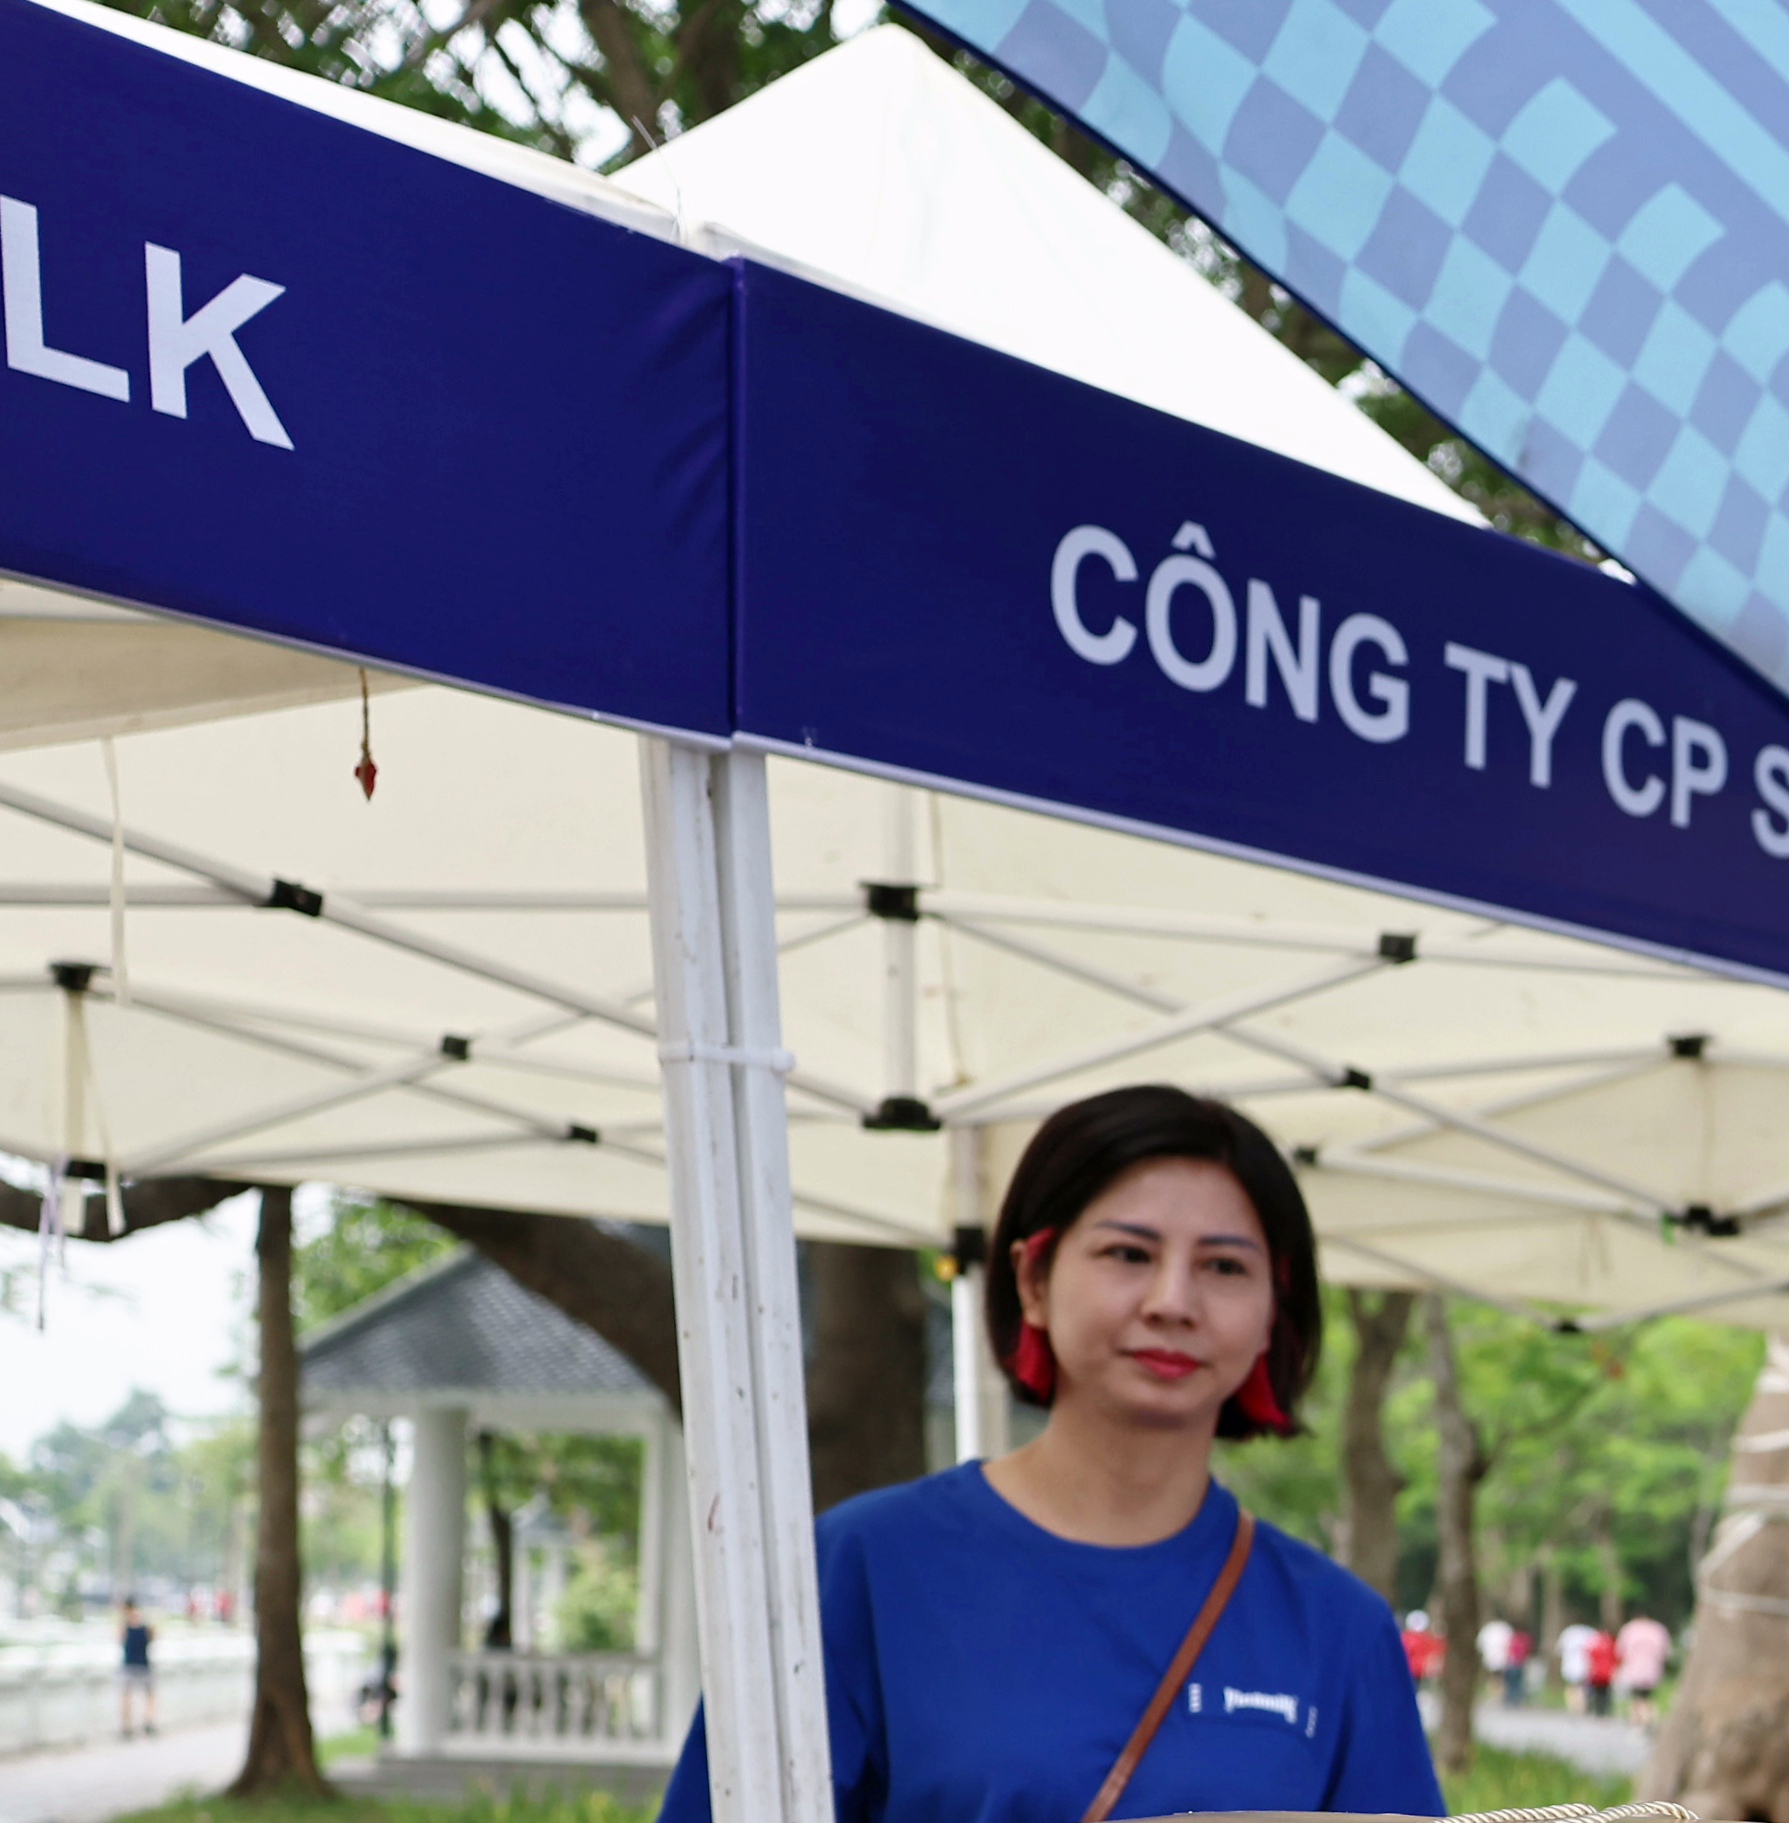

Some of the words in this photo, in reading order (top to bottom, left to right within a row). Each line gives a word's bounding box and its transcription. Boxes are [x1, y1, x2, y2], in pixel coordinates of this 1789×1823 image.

[1052, 521, 1409, 743] CÔNG
[1444, 643, 1577, 788] TY
[1601, 700, 1728, 827] CP
